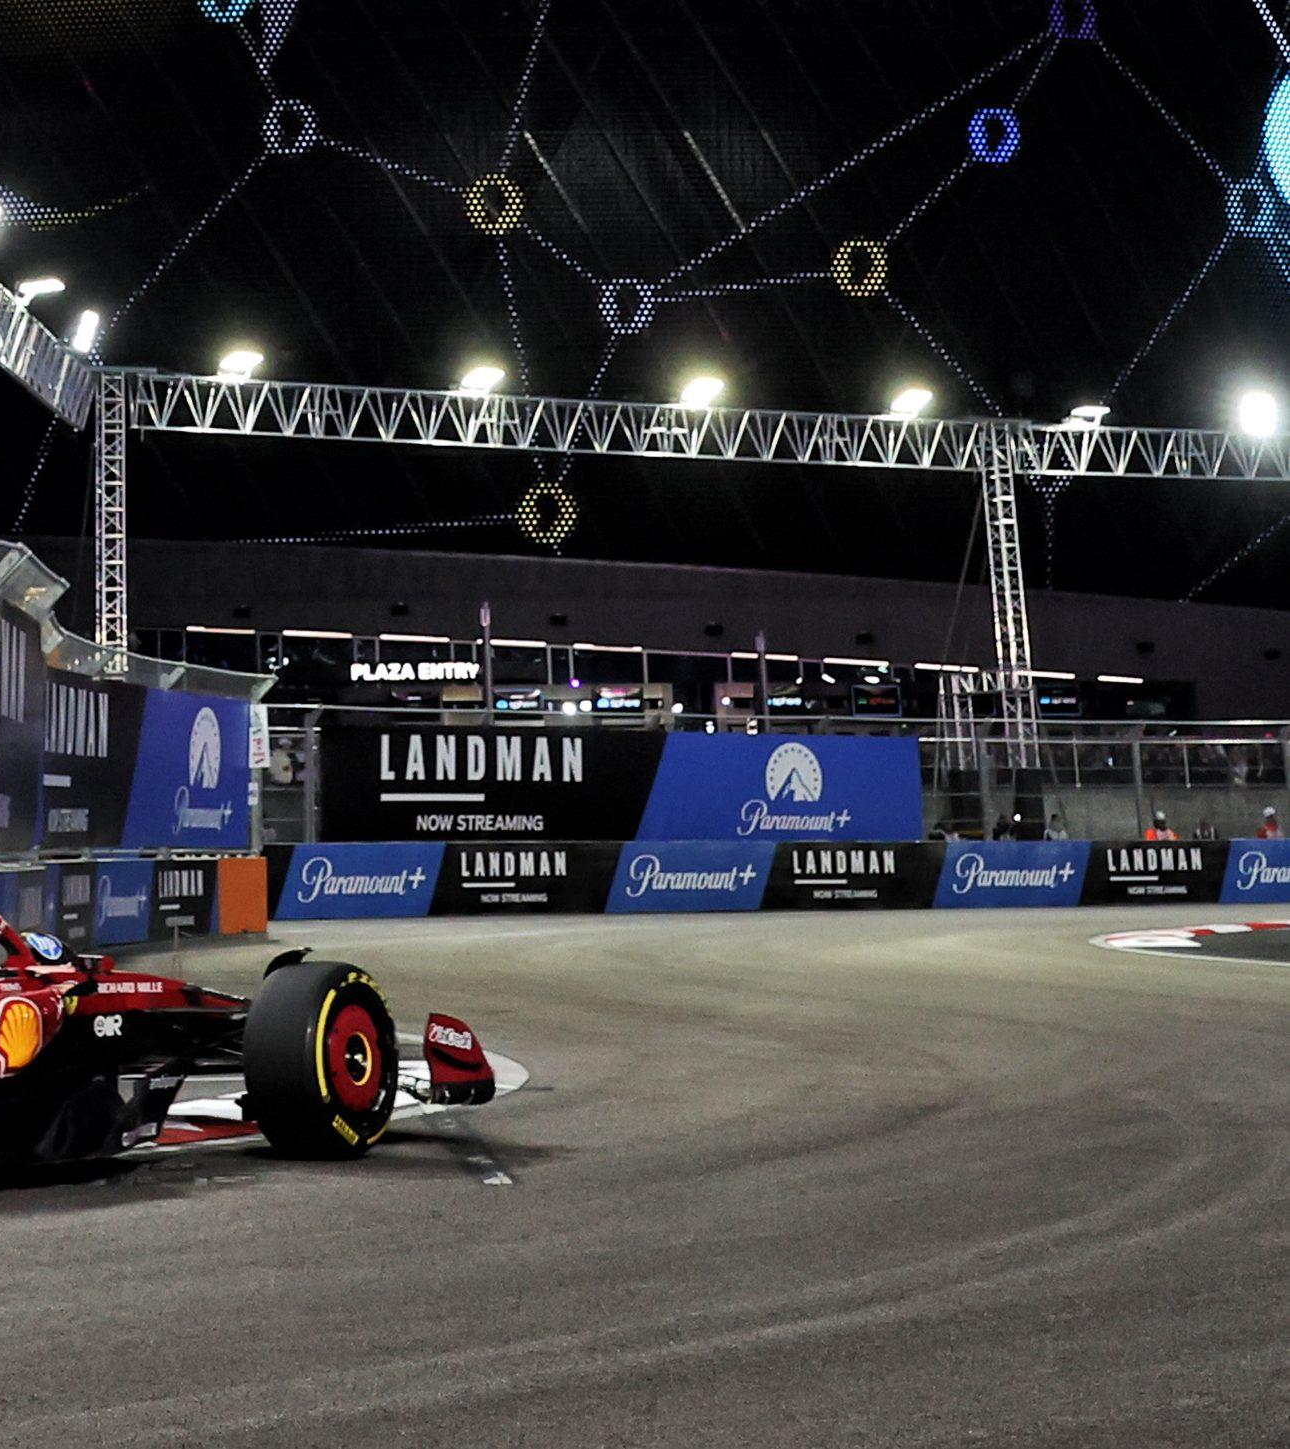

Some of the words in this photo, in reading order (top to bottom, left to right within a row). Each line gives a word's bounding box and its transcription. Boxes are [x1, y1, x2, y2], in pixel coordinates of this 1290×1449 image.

[350, 662, 415, 681] PLAZA
[418, 661, 480, 680] ENTRY
[381, 734, 583, 782] LANDMAN
[416, 815, 454, 831] NOW
[456, 815, 544, 831] STREAMING
[736, 799, 851, 836] Paramount+
[461, 851, 567, 877] LANDMAN
[792, 850, 895, 875] LANDMAN
[952, 853, 1075, 894] Paramount+
[1107, 848, 1202, 871] LANDMAN
[297, 857, 426, 903] Paramount+
[625, 854, 757, 898] Paramount+
